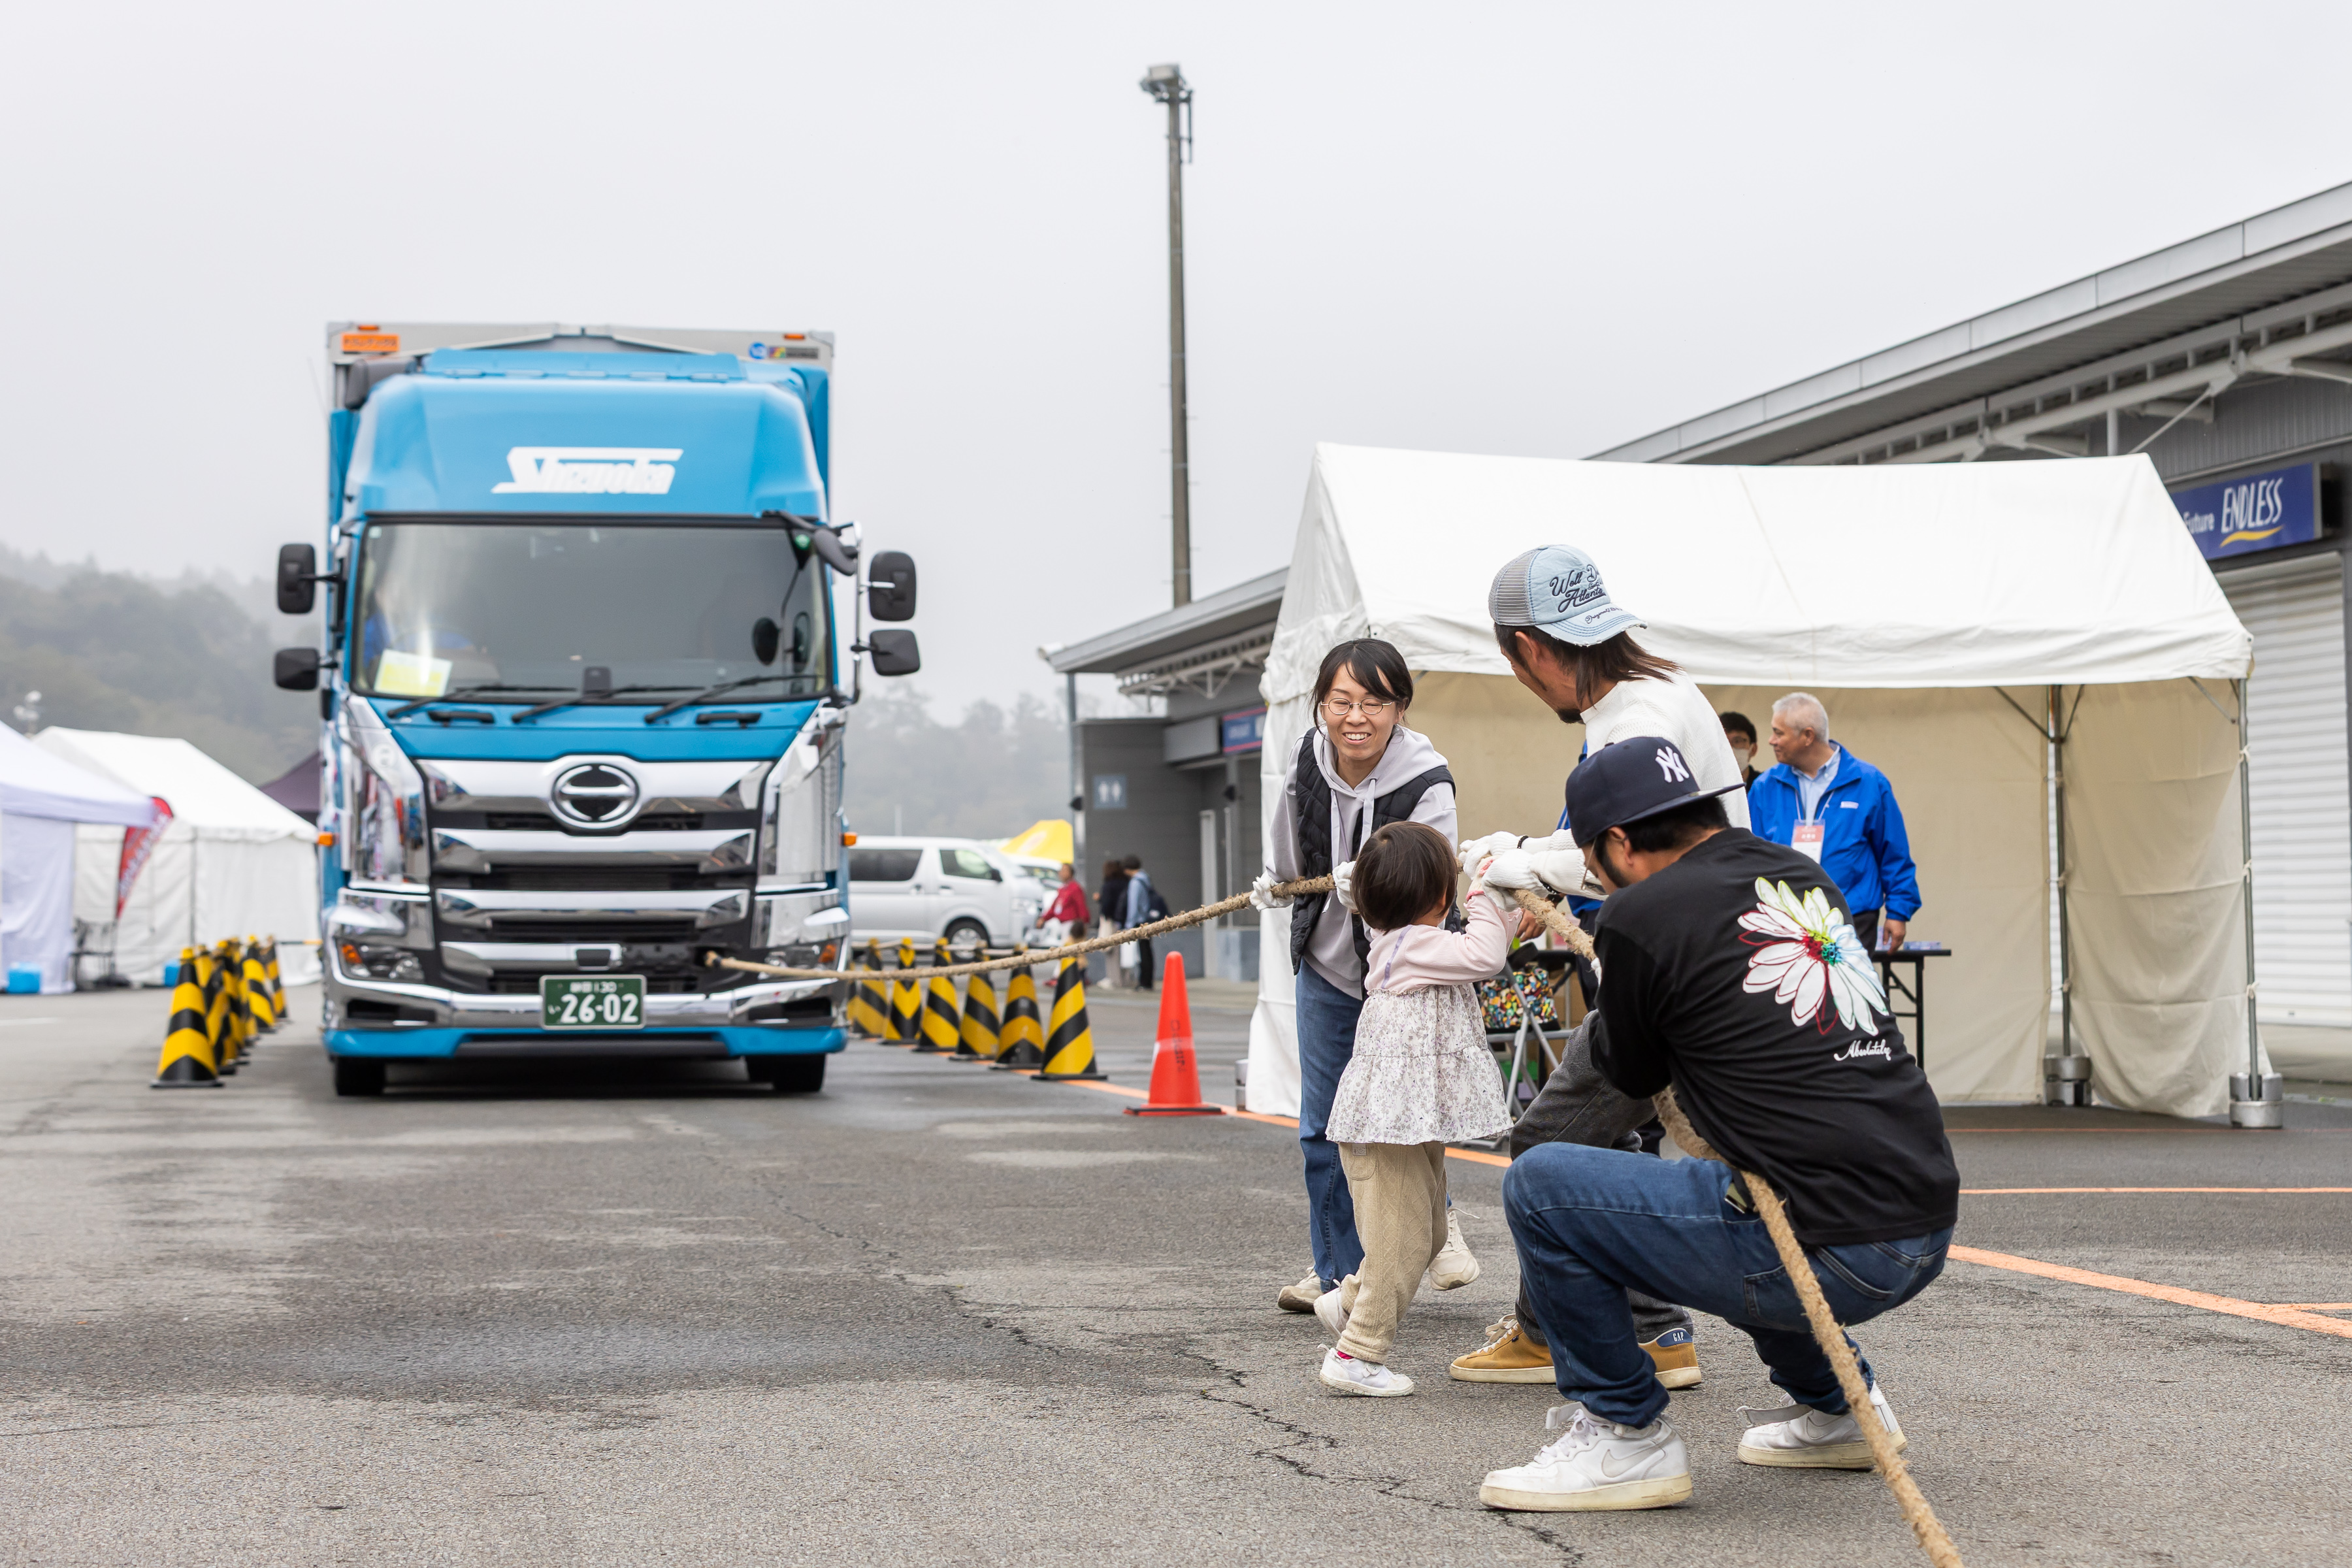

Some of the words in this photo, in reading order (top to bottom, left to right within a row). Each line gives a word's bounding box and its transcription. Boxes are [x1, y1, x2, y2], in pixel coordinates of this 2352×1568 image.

[2221, 476, 2283, 533] ENDLESS
[1655, 745, 1690, 783] NY
[561, 993, 638, 1024] 26-02
[1833, 1039, 1892, 1062] Absolutely
[1673, 1331, 1684, 1341] GAP
